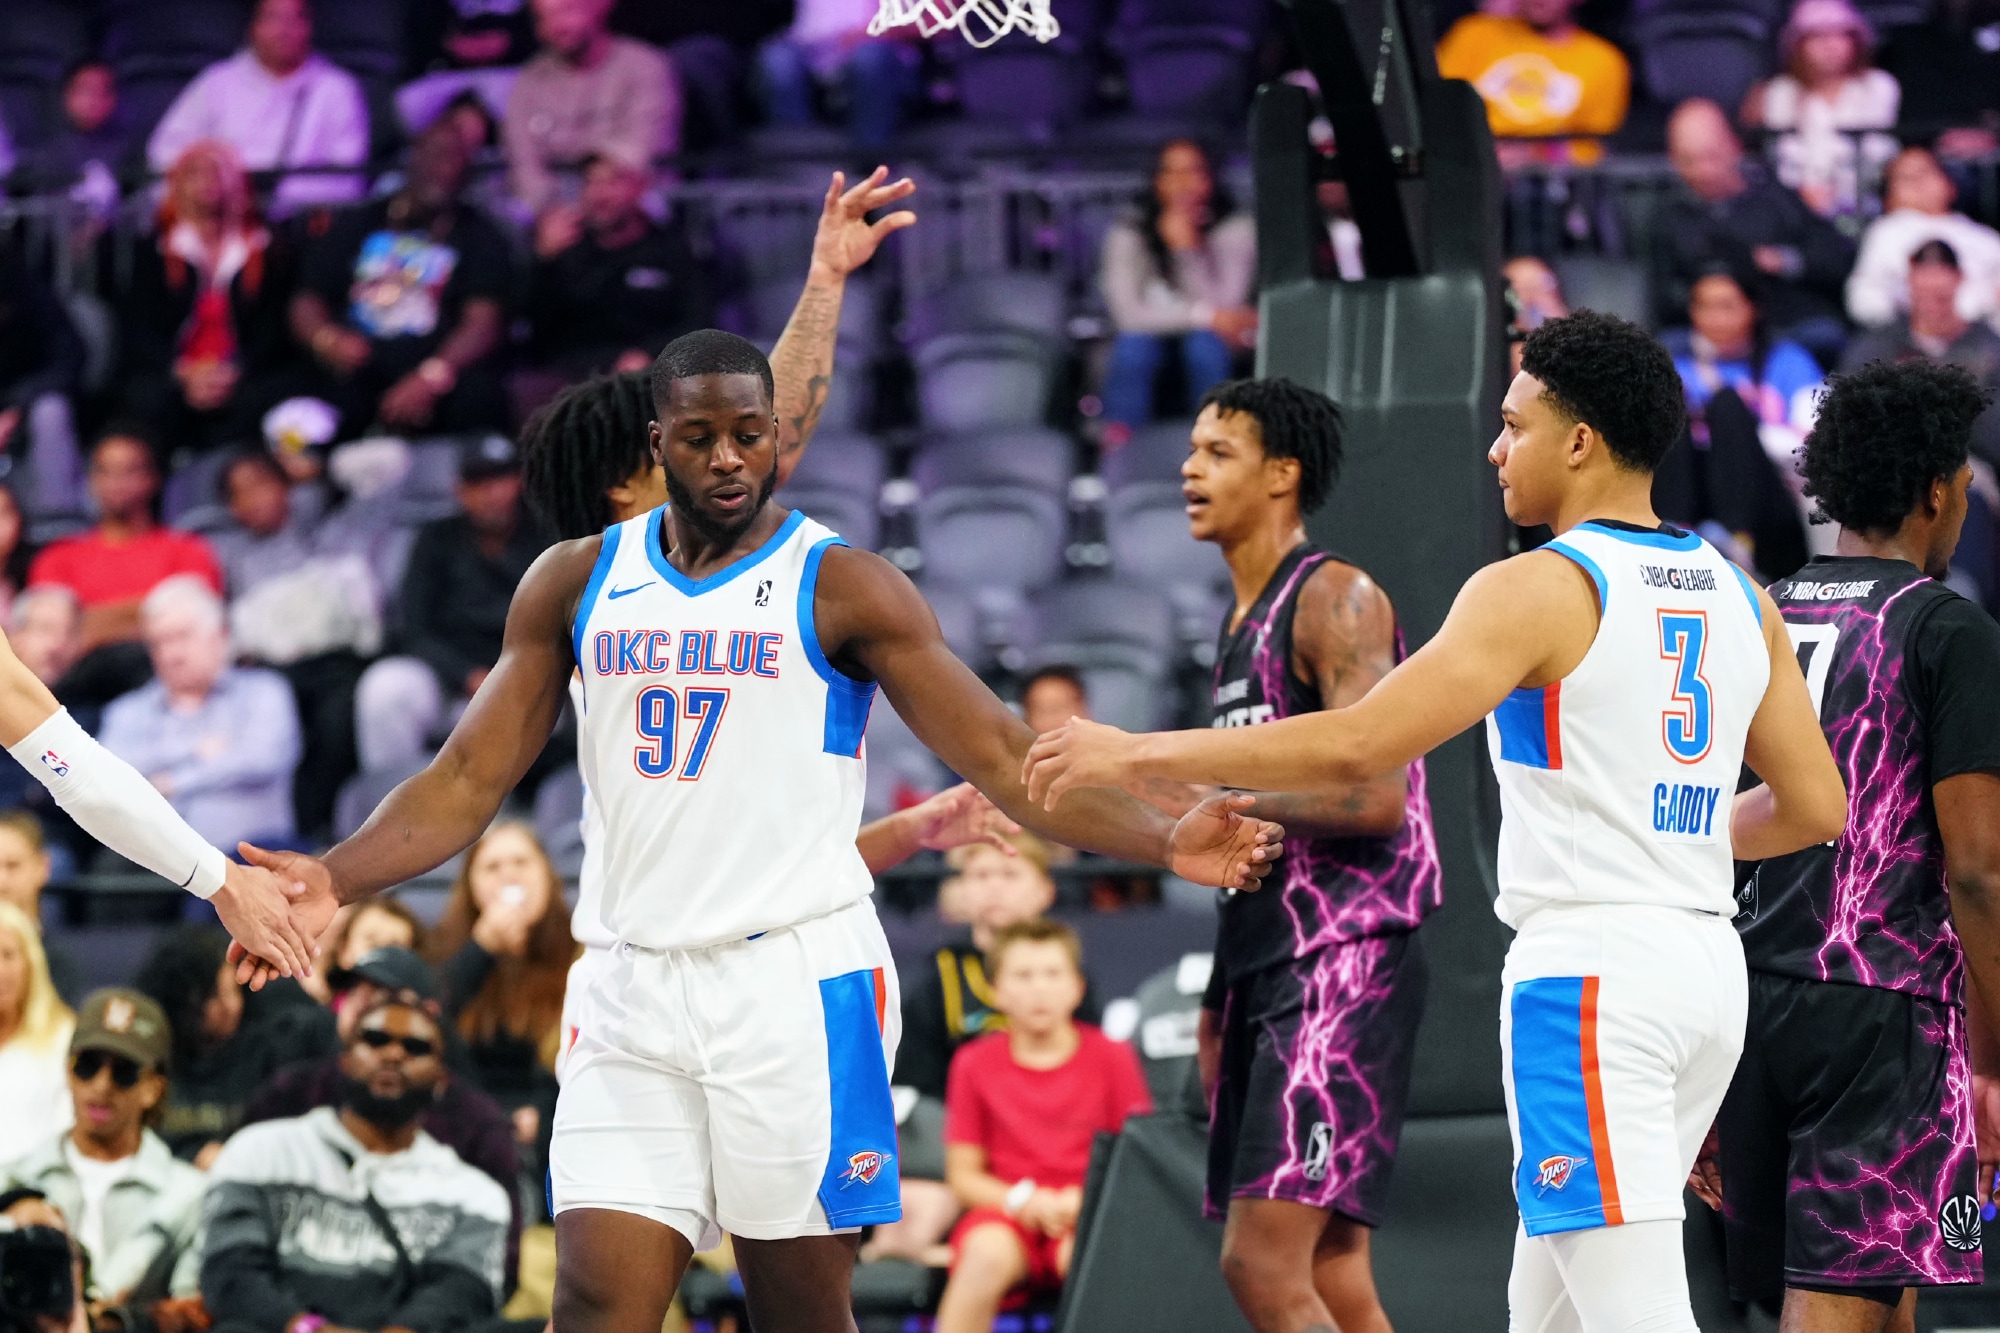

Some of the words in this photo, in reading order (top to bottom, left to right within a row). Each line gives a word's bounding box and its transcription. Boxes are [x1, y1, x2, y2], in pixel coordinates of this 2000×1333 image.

[594, 630, 670, 676] OKC
[676, 630, 783, 679] BLUE
[1656, 608, 1713, 765] 3
[633, 684, 730, 781] 97
[1653, 782, 1720, 836] GADDY
[850, 1156, 876, 1181] OKC
[1541, 1161, 1567, 1187] OKC
